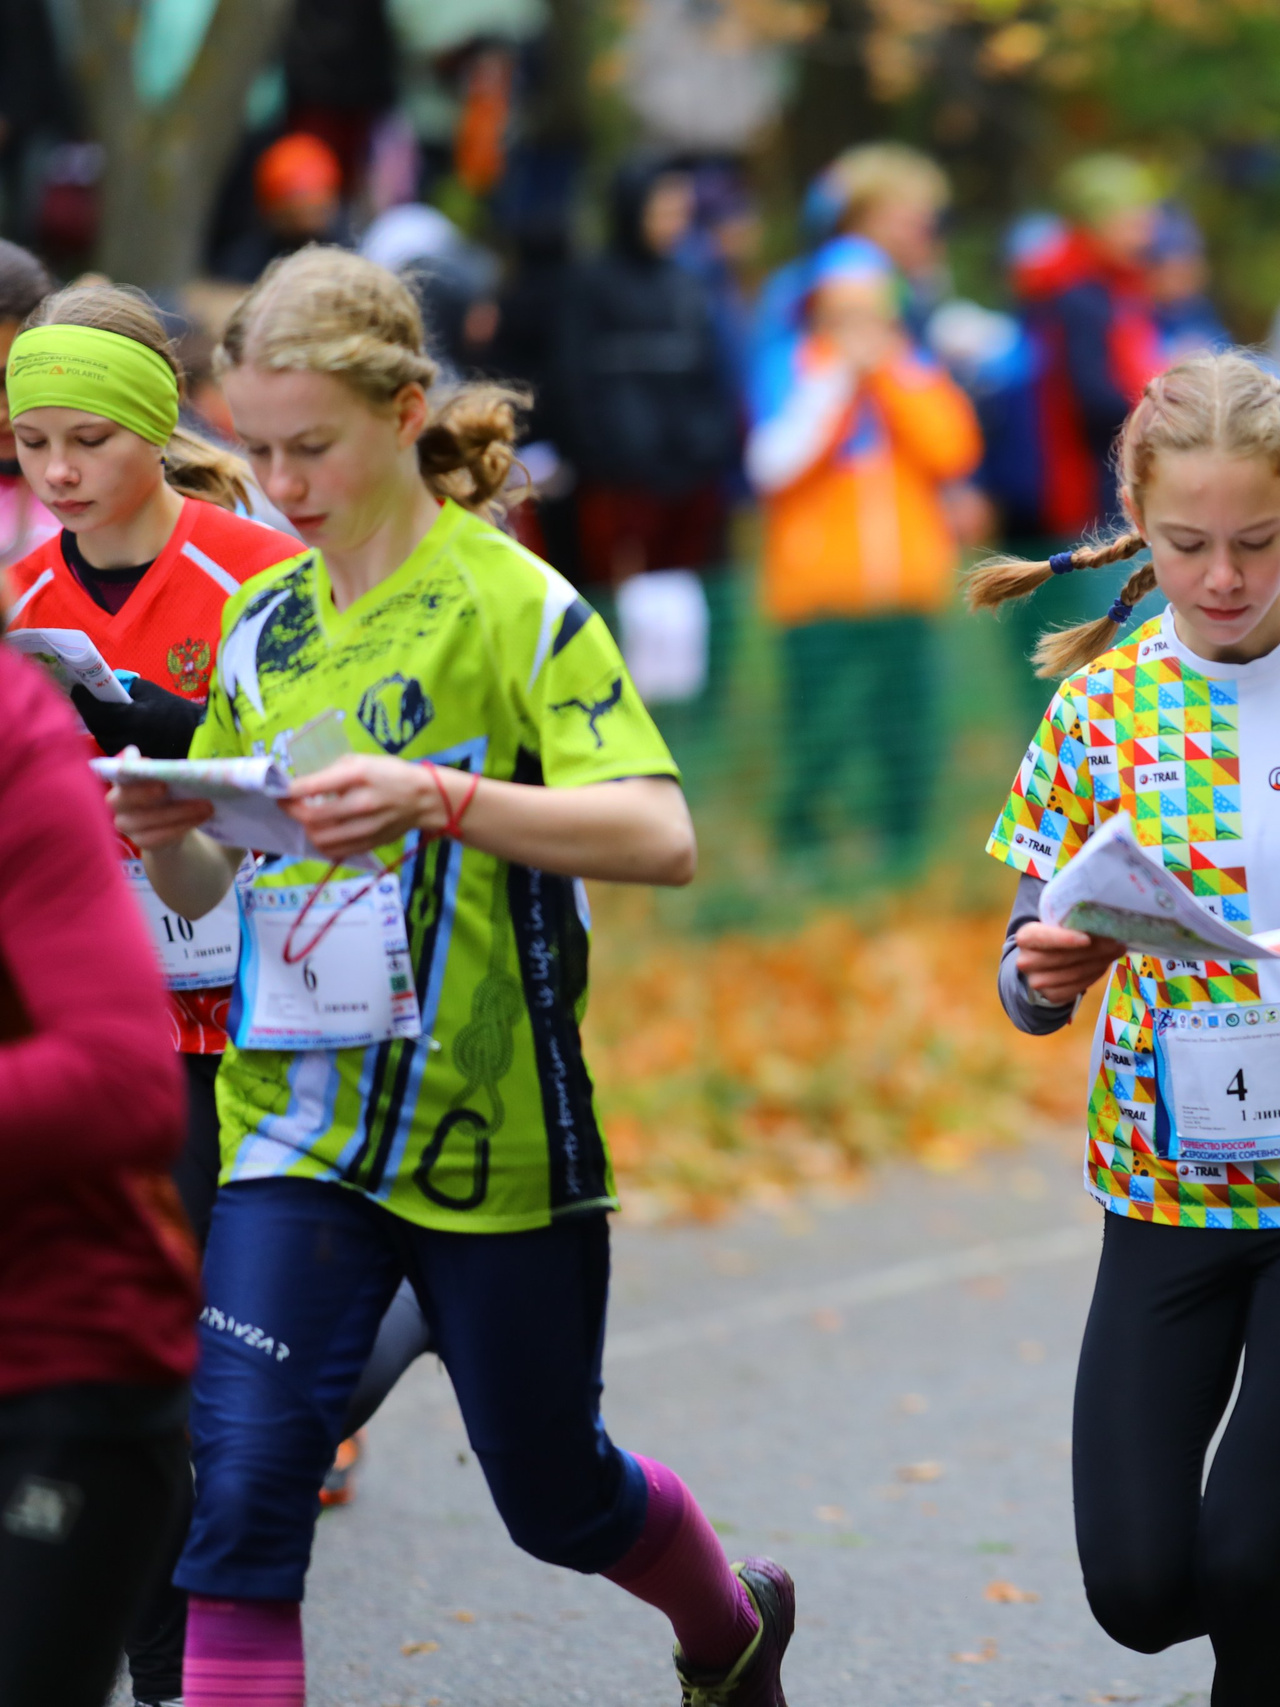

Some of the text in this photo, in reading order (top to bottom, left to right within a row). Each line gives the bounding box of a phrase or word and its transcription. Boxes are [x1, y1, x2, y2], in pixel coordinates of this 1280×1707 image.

[161, 914, 194, 943] 10
[303, 957, 317, 993] 6
[1226, 1068, 1248, 1101] 4
[1241, 1109, 1247, 1121] 1
[1221, 1140, 1257, 1151] РОССИИ
